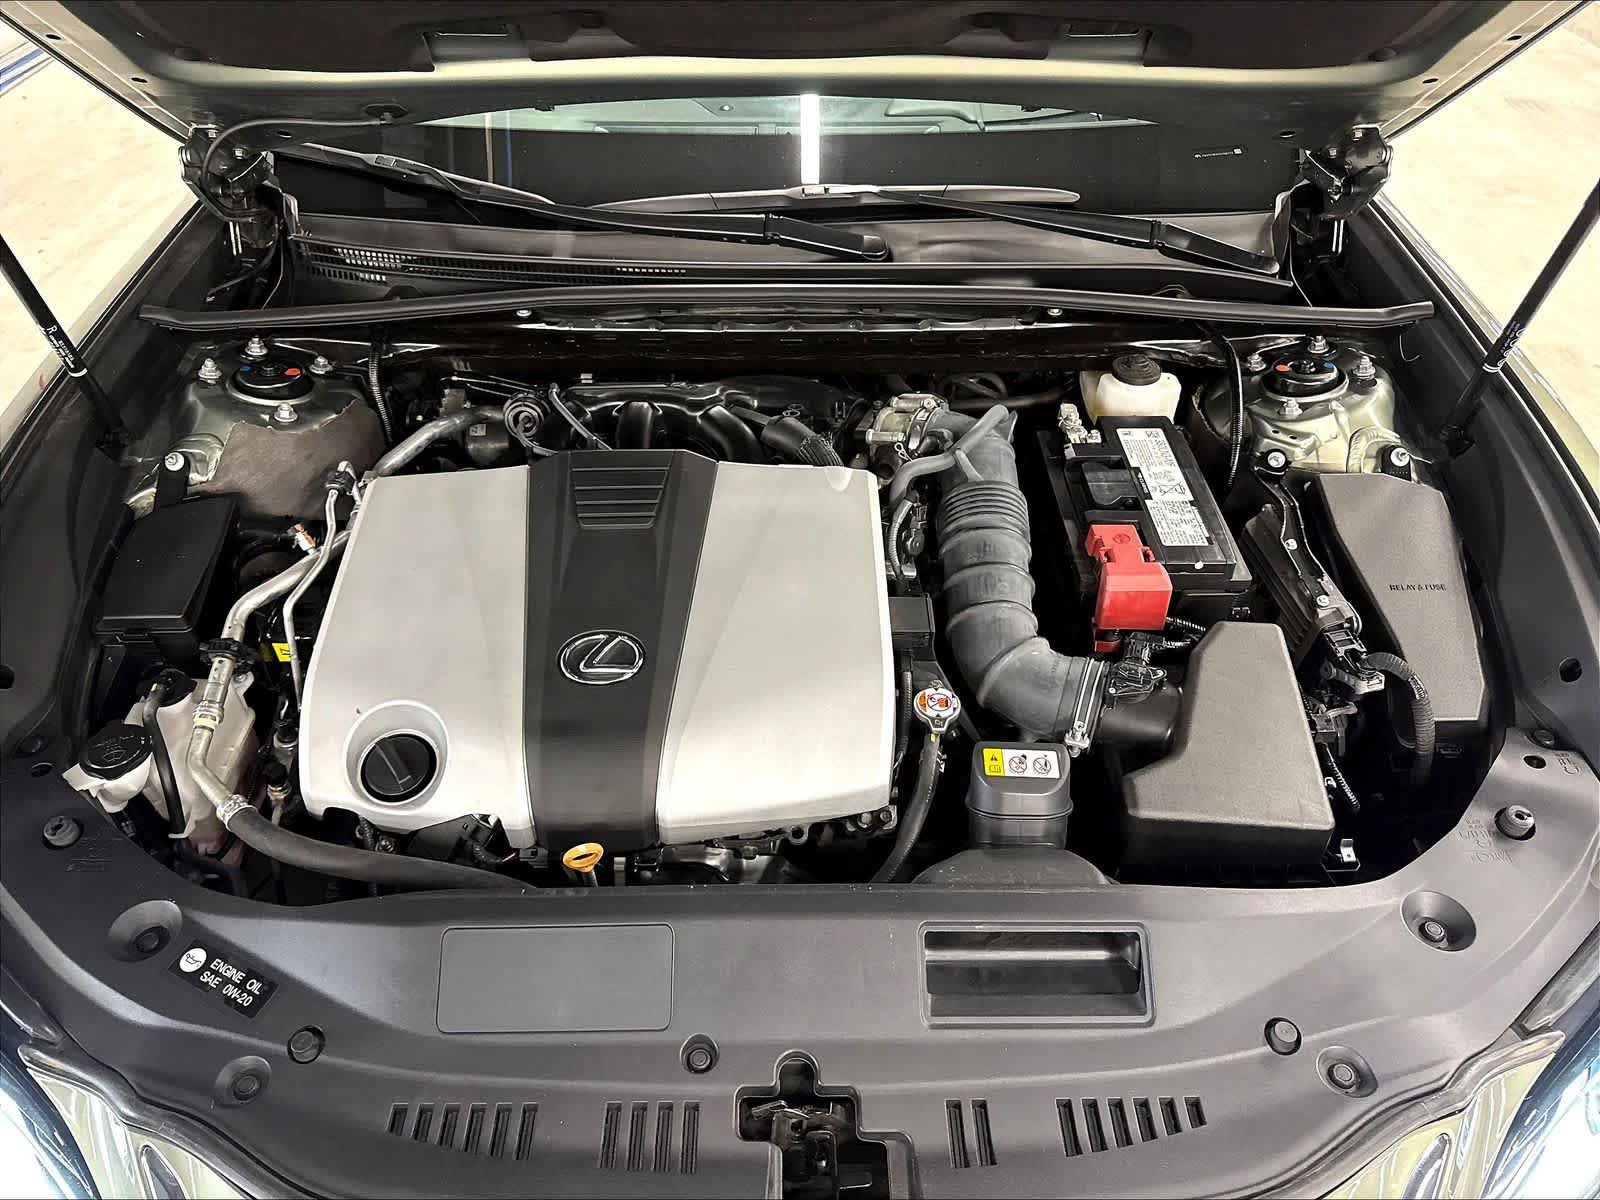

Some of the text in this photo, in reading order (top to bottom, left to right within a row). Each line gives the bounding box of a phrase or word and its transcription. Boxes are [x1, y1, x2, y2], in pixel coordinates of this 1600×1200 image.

[200, 971, 253, 1006] SAE 0W-20
[210, 958, 262, 995] ENGINE OIL
